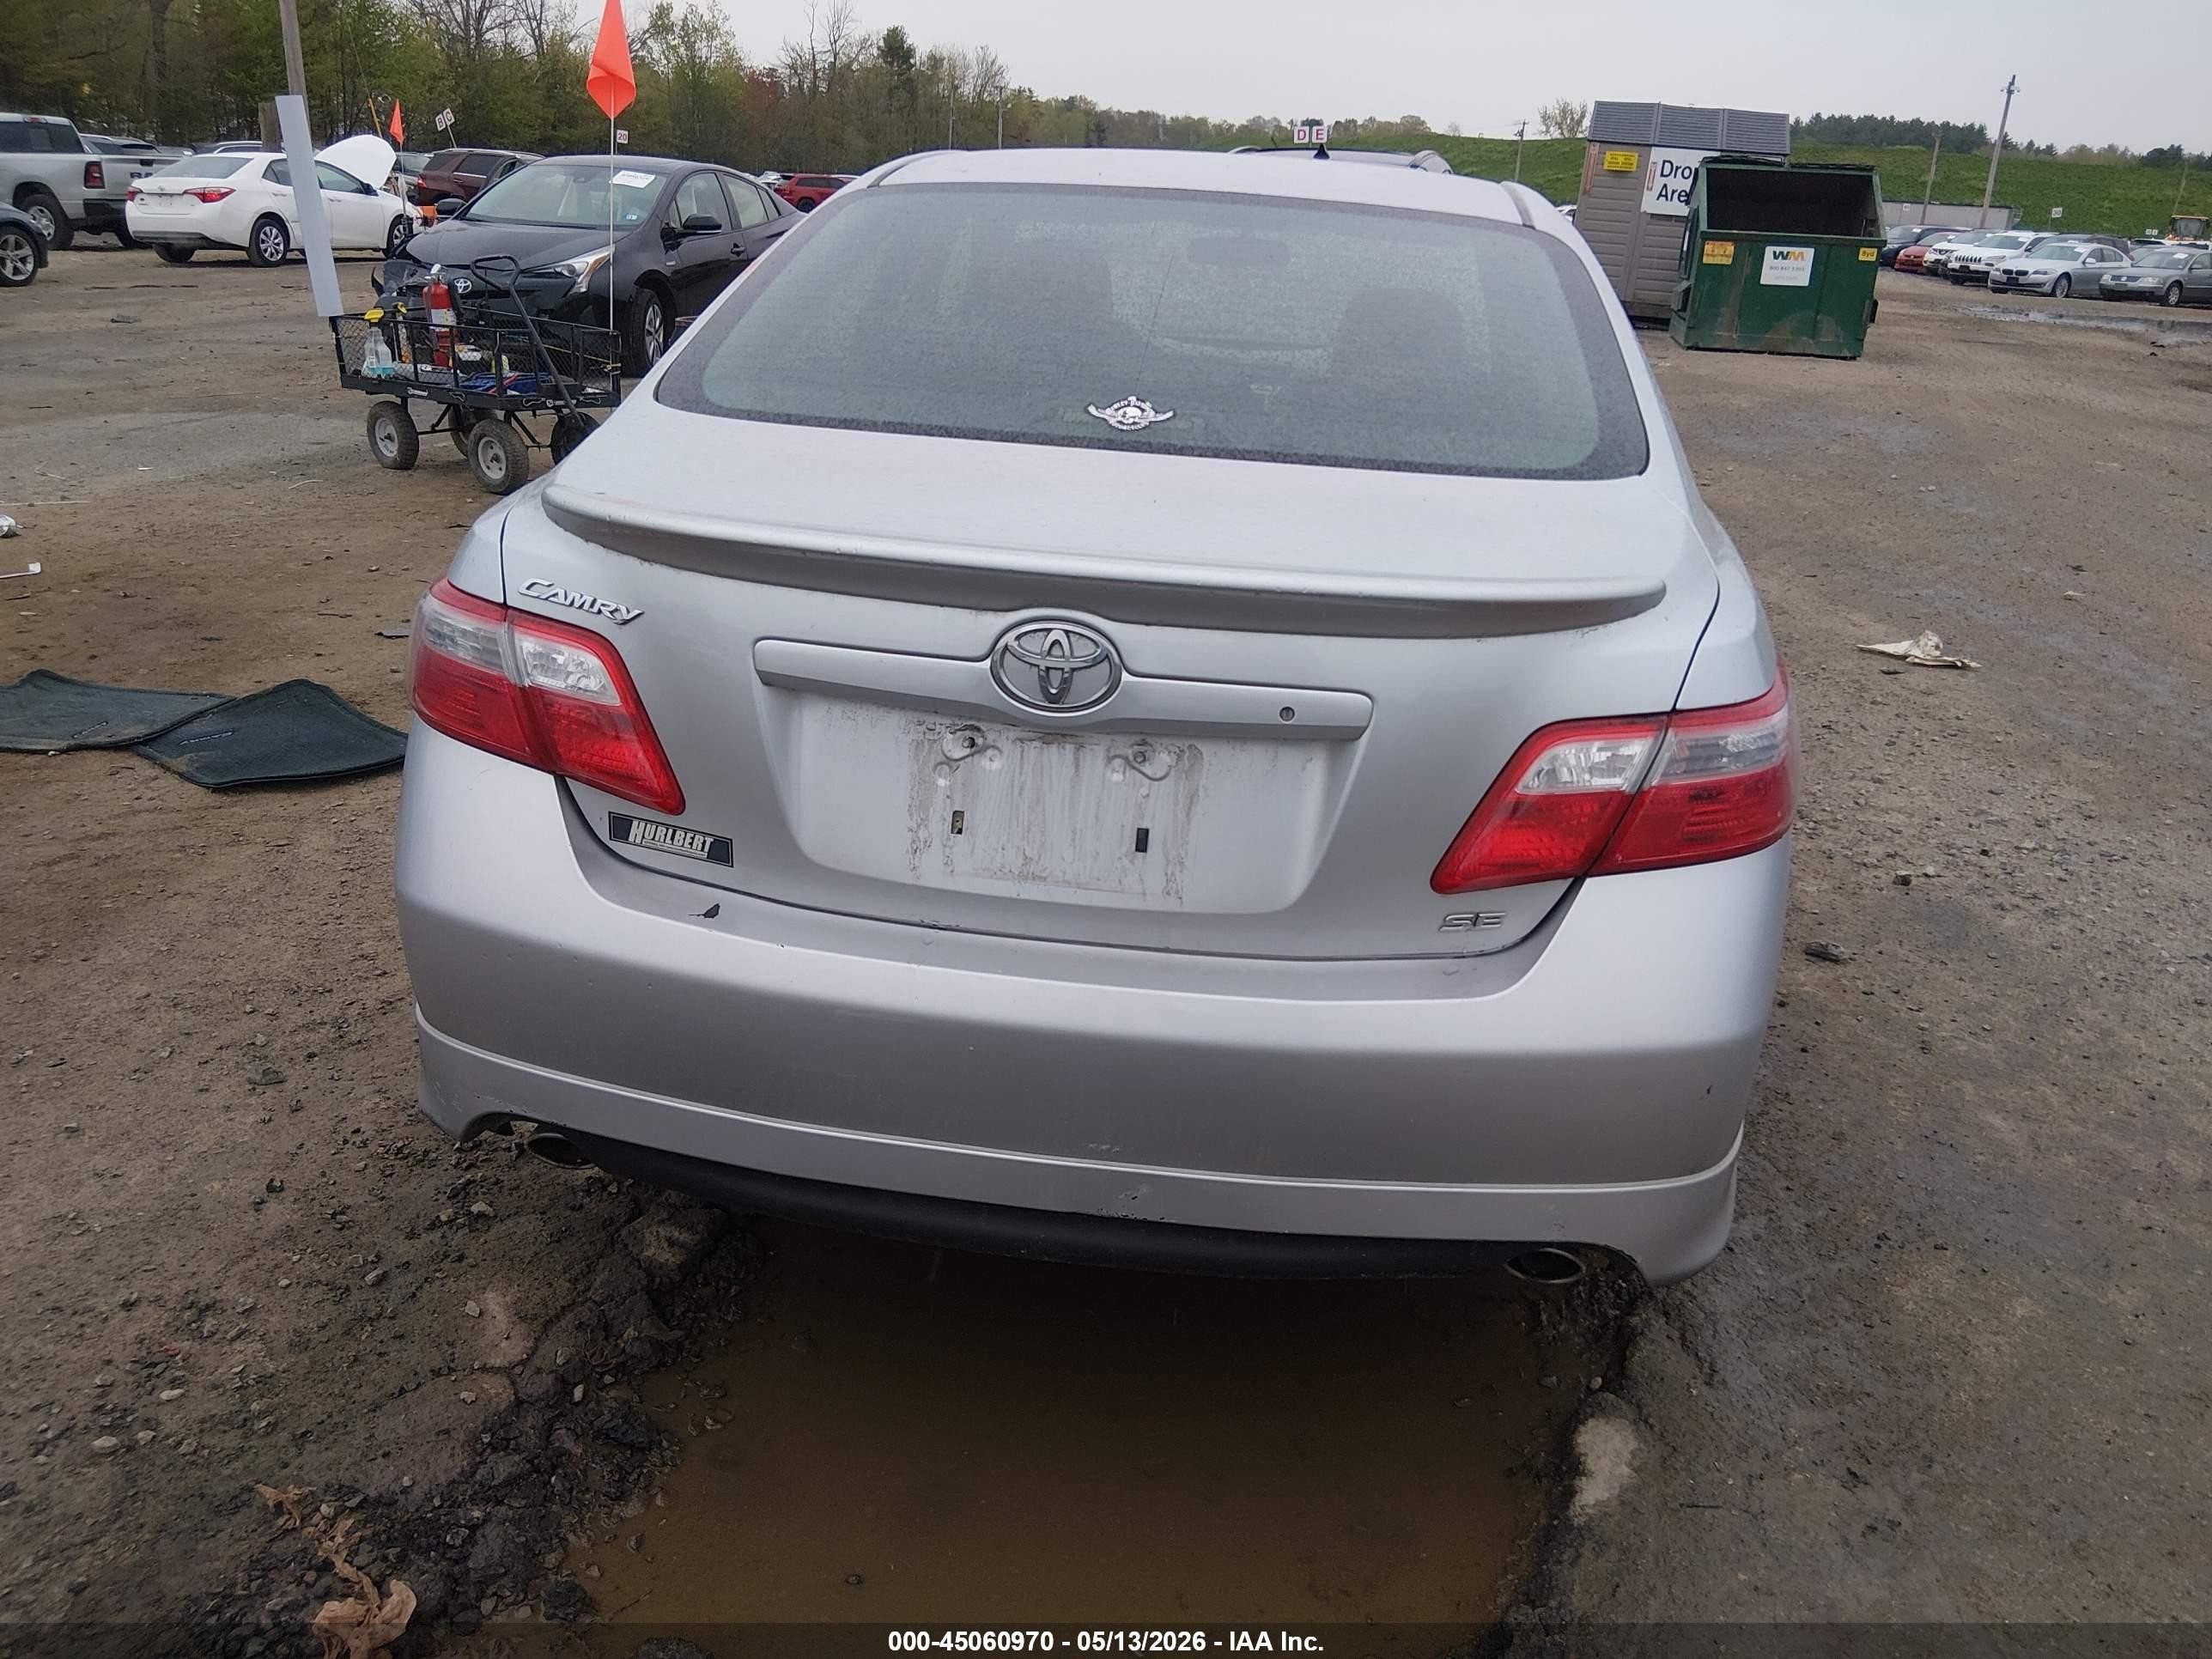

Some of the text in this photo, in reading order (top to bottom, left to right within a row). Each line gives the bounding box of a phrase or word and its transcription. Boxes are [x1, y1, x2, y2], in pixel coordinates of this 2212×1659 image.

[437, 112, 453, 129] B C
[617, 132, 628, 142] 20
[1297, 129, 1324, 141] D E
[1660, 160, 1698, 180] Dro
[1656, 183, 1690, 204] Are
[1772, 250, 1805, 261] WM
[518, 578, 645, 625] CAMRY
[628, 819, 714, 853] HURLBERT
[1438, 911, 1506, 932] SE
